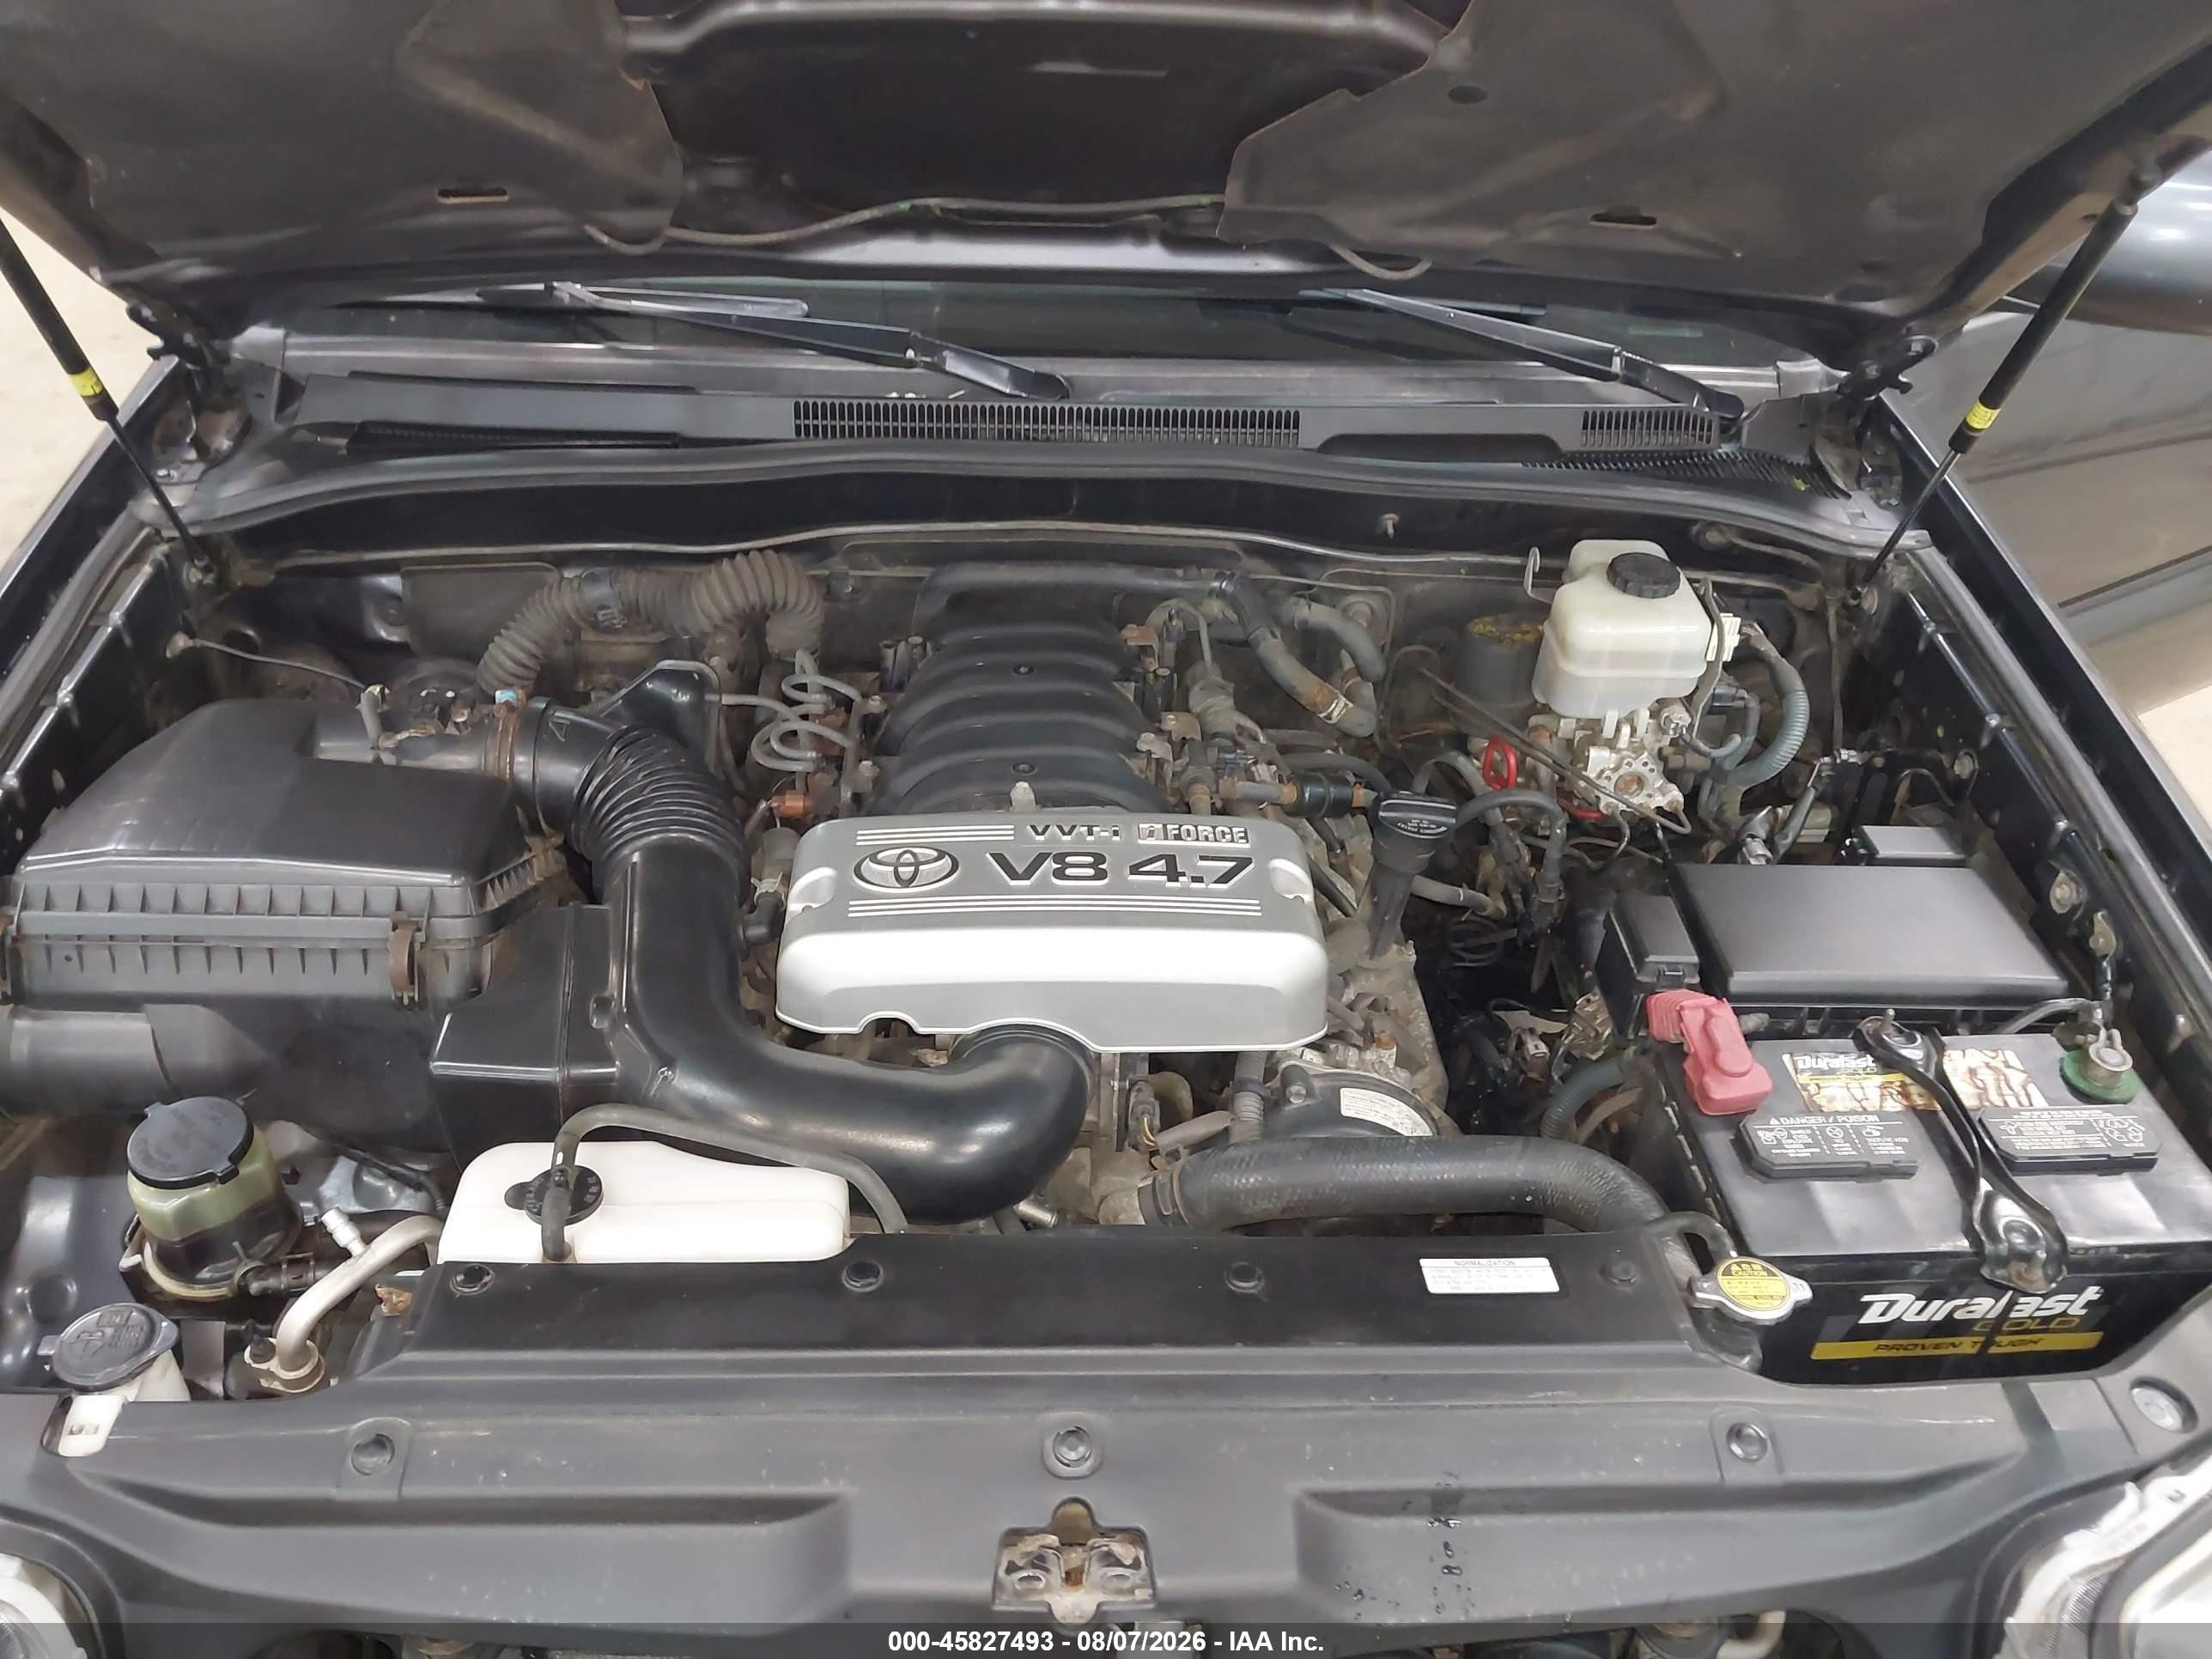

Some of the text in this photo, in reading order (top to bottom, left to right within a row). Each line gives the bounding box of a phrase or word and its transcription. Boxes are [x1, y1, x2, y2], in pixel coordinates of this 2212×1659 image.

[986, 851, 1255, 889] V8 4.7
[1779, 1116, 1826, 1125] DANGER
[1838, 1115, 1881, 1123] POISON
[1857, 1285, 2104, 1324] Duralast
[1873, 1338, 2045, 1352] PROVEN TUGH
